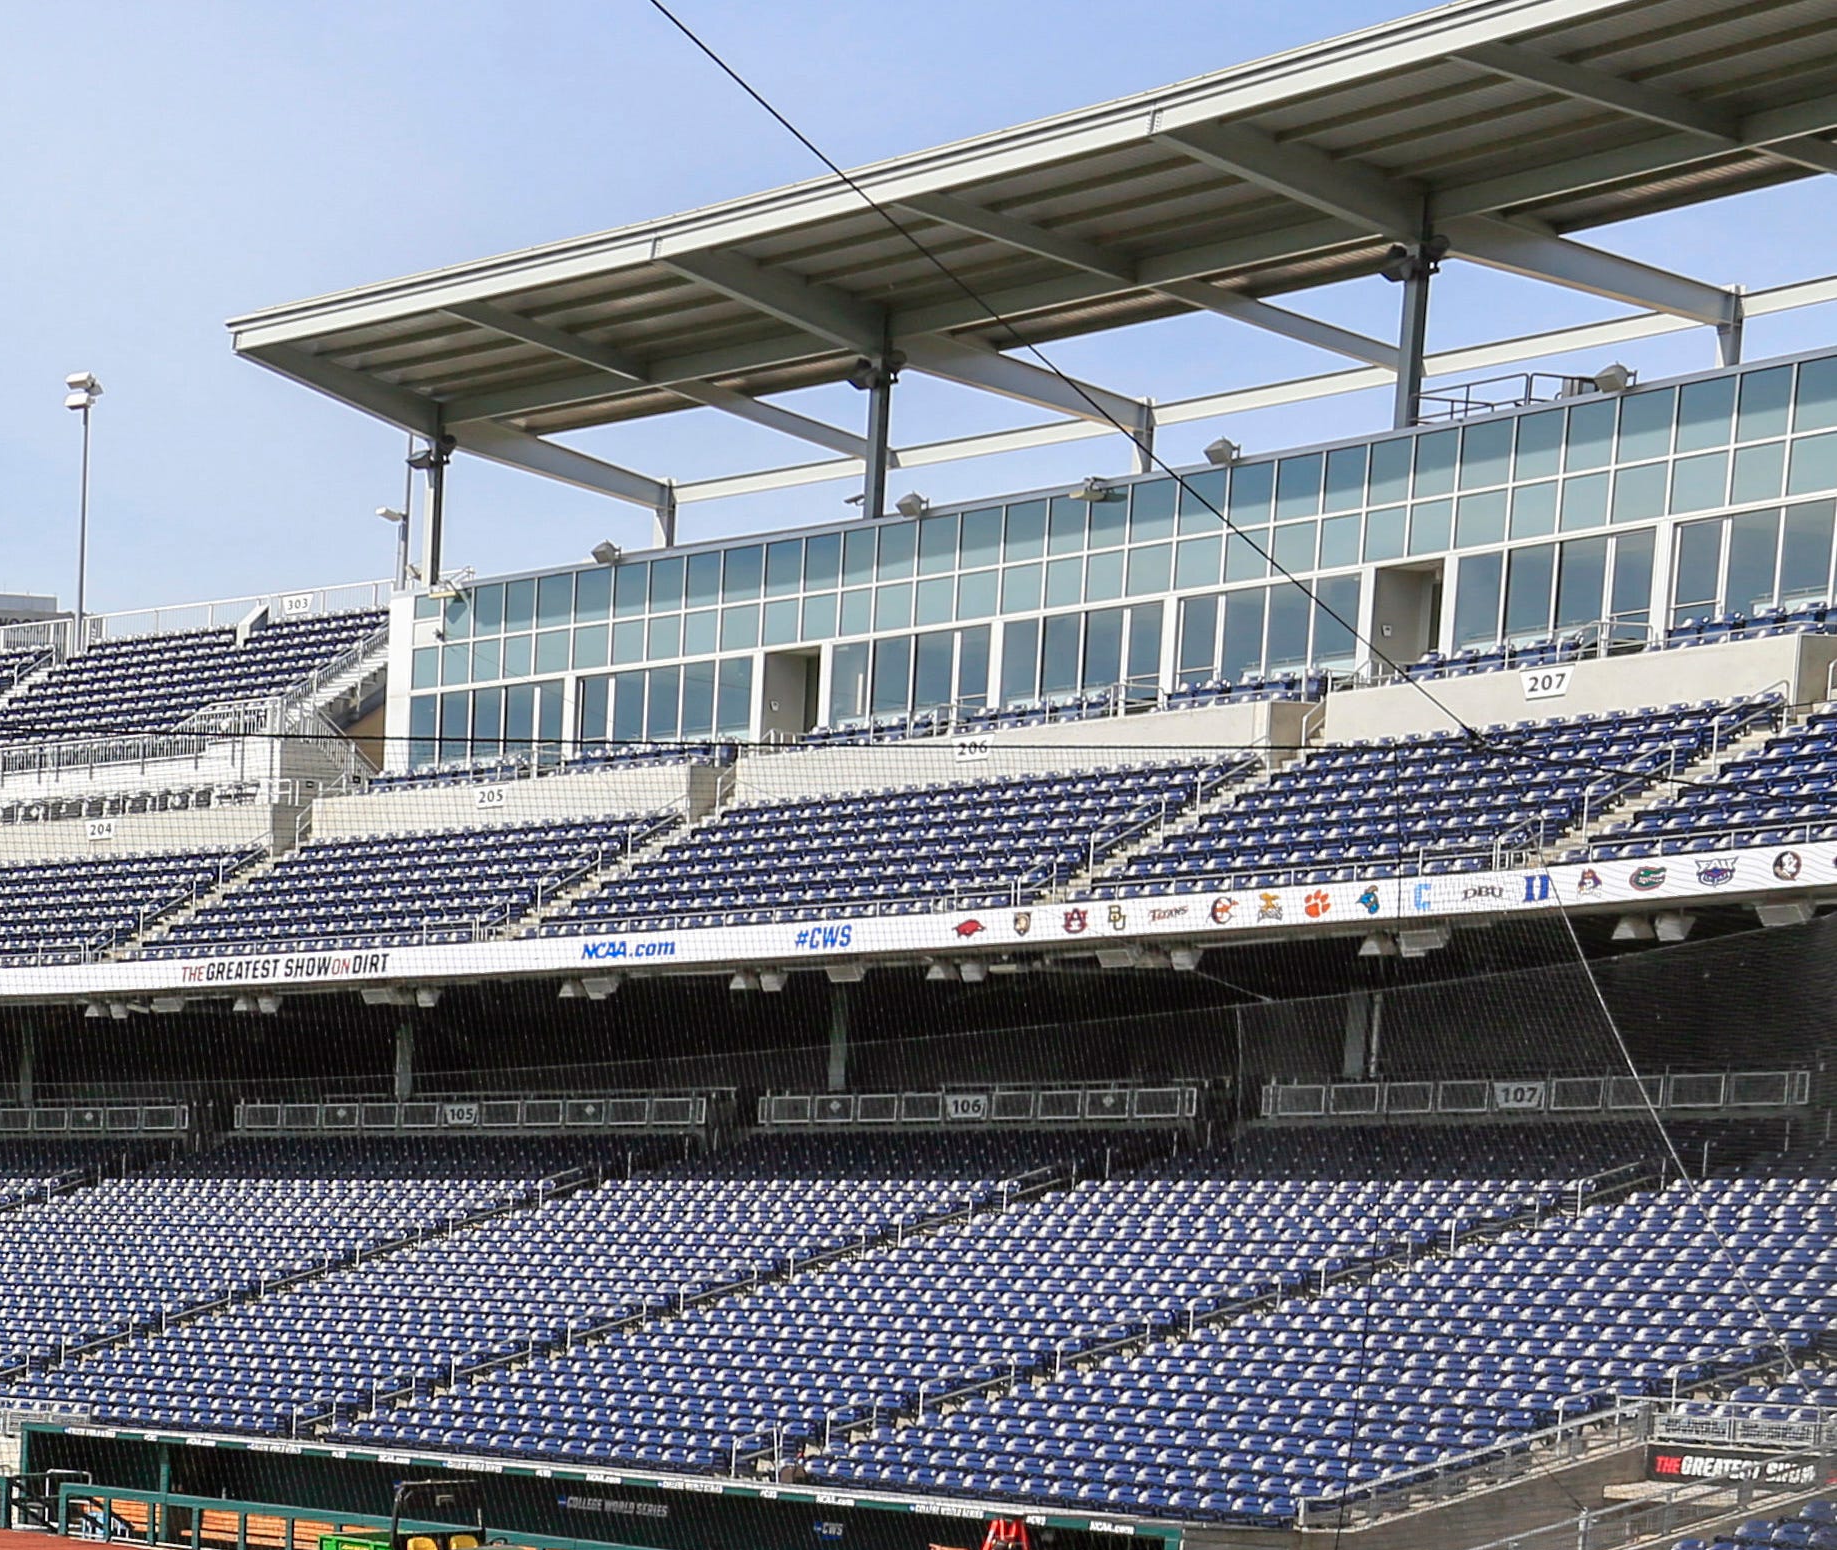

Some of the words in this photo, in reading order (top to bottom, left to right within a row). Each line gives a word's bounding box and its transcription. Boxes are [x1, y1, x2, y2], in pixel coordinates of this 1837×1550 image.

[288, 599, 309, 610] 303
[1528, 672, 1567, 693] 207
[958, 740, 988, 757] 206
[479, 790, 504, 804] 205
[89, 824, 112, 836] 204
[1463, 885, 1504, 900] DBU
[795, 924, 852, 949] #CWS
[581, 940, 676, 960] NCAA.com
[182, 965, 205, 982] THE
[206, 958, 280, 981] GREATEST
[284, 957, 331, 977] SHOW
[331, 957, 350, 975] ON
[352, 953, 390, 974] DIRT
[1500, 1087, 1538, 1104] 107
[449, 1108, 472, 1120] 105
[952, 1099, 981, 1113] 106
[1656, 1455, 1681, 1474] THE
[567, 1496, 602, 1511] COLLEGE
[604, 1499, 635, 1514] WORLD
[635, 1502, 668, 1518] SERIES
[822, 1521, 844, 1536] CWS
[1089, 1520, 1135, 1535] NCAA.com
